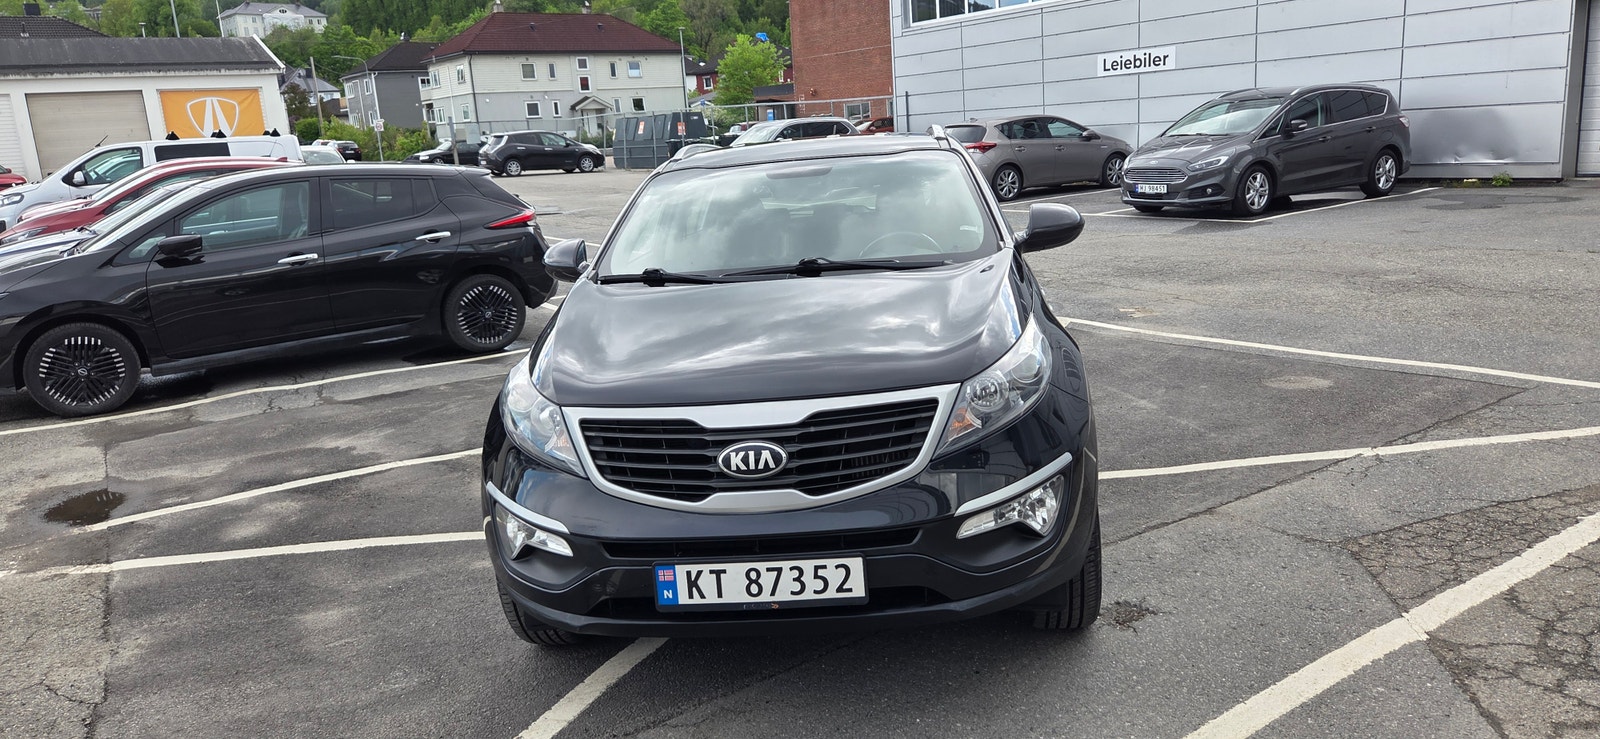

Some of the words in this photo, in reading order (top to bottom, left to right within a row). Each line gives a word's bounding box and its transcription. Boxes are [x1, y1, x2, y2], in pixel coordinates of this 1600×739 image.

[1103, 52, 1169, 72] Leiebiler
[729, 449, 776, 471] KIA
[685, 568, 727, 600] KT
[744, 563, 853, 599] 87352
[663, 589, 673, 599] N
